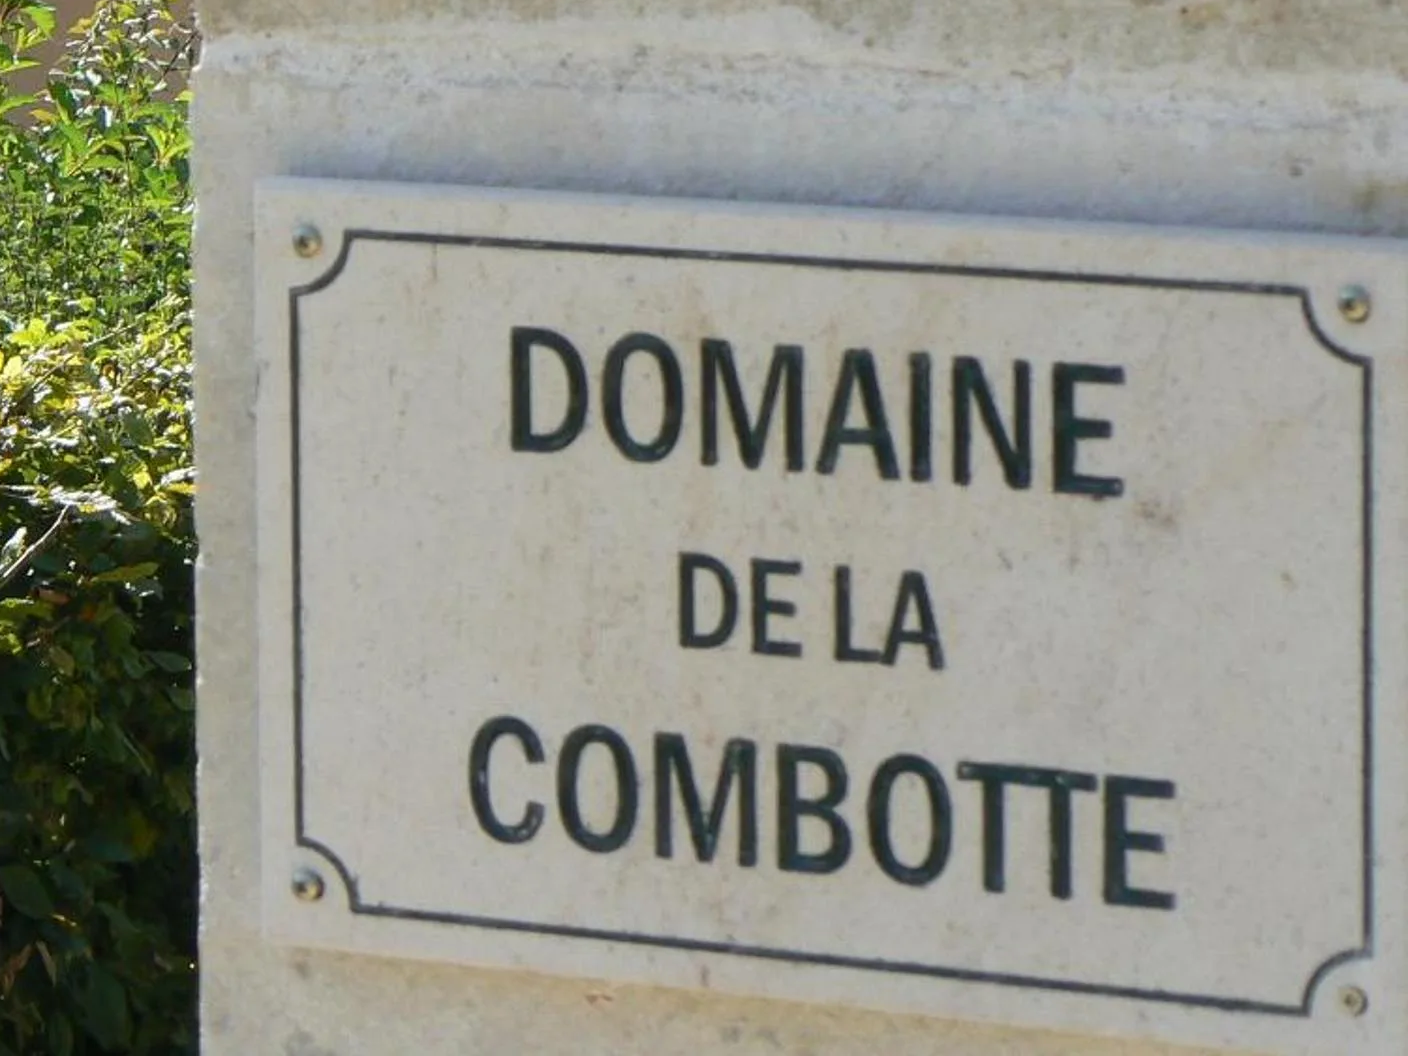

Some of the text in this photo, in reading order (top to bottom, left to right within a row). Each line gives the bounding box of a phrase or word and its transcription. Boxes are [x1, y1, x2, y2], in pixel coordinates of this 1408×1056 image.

[509, 325, 1126, 501] DOMAINE
[677, 550, 945, 671] DE LA
[467, 714, 1176, 911] COMBOTTE
